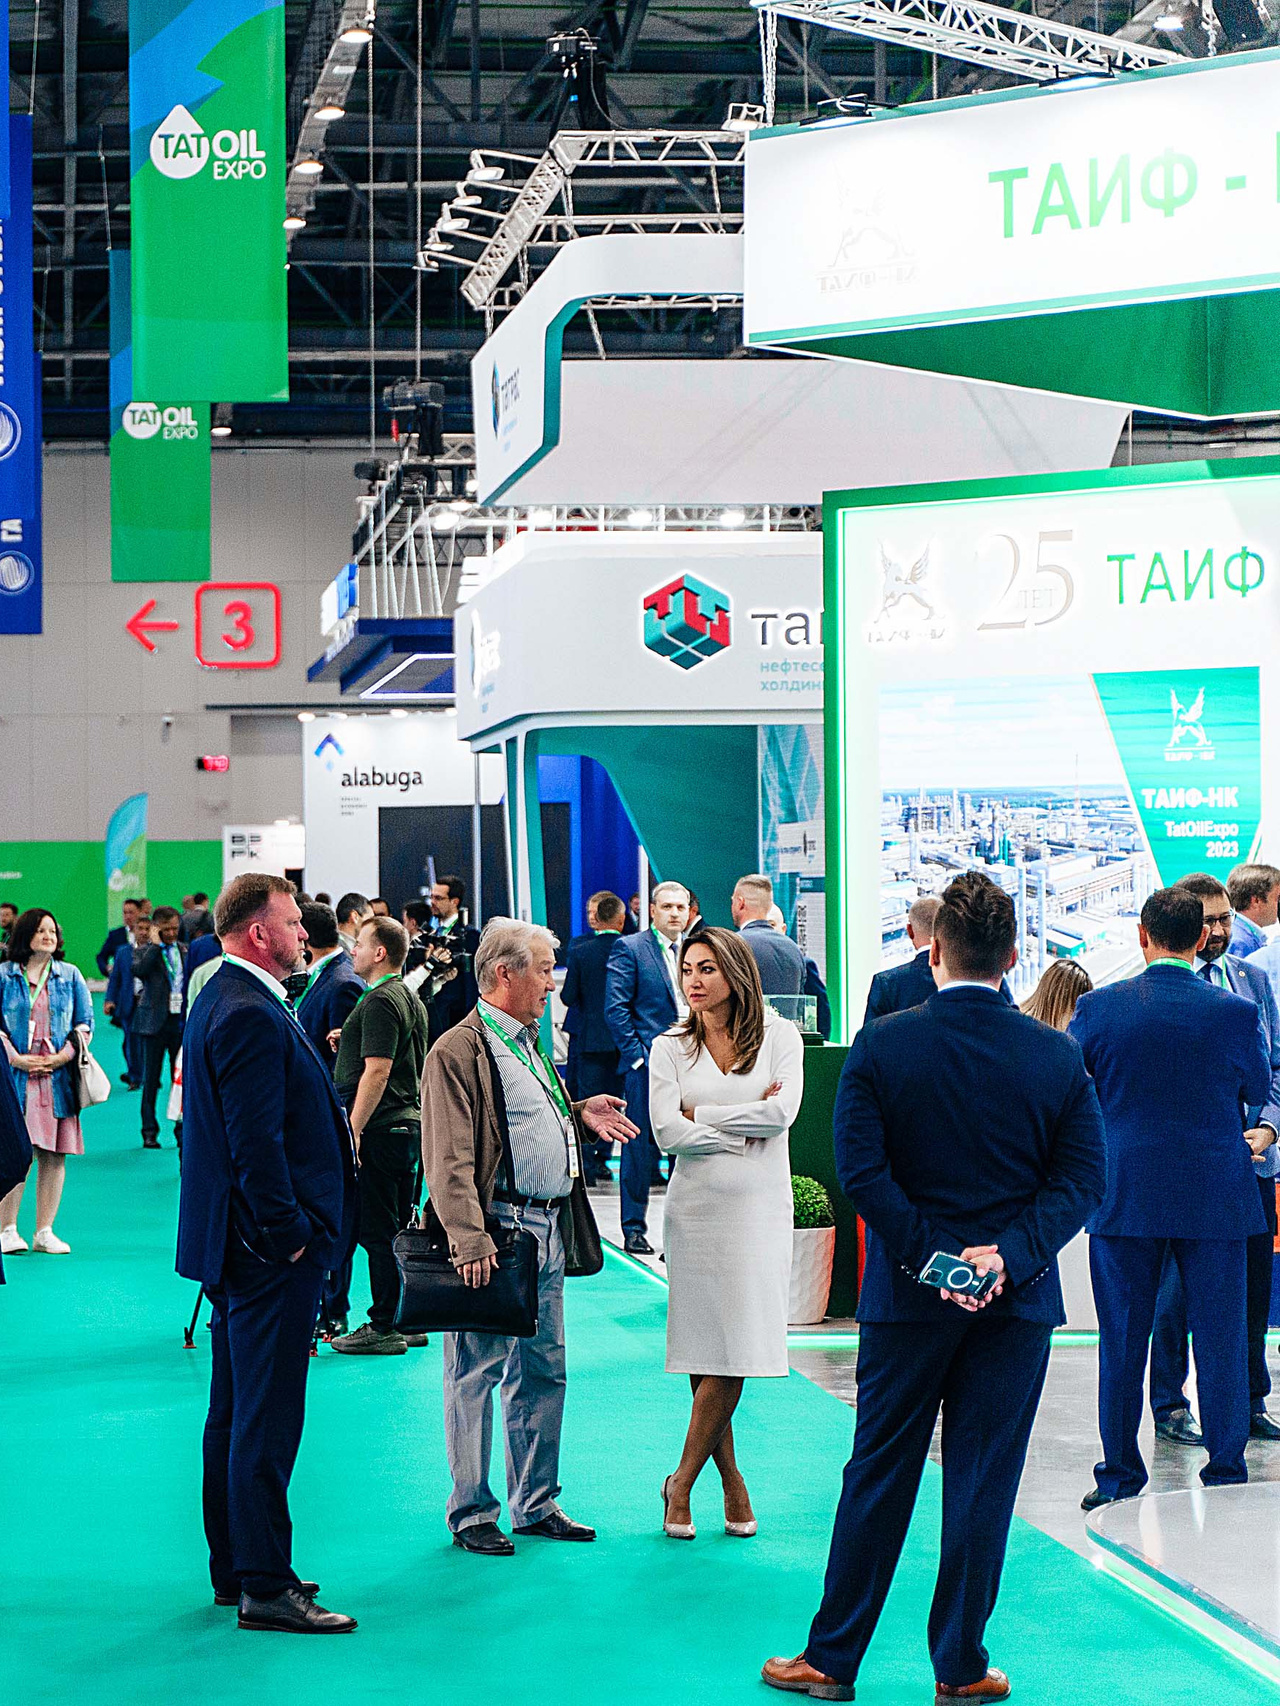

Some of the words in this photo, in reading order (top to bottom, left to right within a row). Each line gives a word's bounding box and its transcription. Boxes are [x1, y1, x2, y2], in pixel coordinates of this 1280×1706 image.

[158, 133, 208, 159] TAT
[212, 129, 266, 159] OIL
[213, 160, 267, 180] EXPO
[988, 146, 1199, 238] ТАИФ
[129, 409, 159, 425] TAT
[162, 406, 198, 427] OIL
[162, 426, 199, 440] EXPO
[0, 518, 23, 542] ГА
[975, 529, 1075, 631] 25
[1106, 545, 1266, 605] ТАИФ
[221, 599, 255, 652] 3
[750, 612, 824, 646] та
[760, 680, 824, 693] холдин
[341, 766, 424, 792] alabuga
[1141, 786, 1239, 809] ТАИФ-НК
[1164, 820, 1239, 840] TatOilExpo
[1205, 841, 1239, 858] 2023
